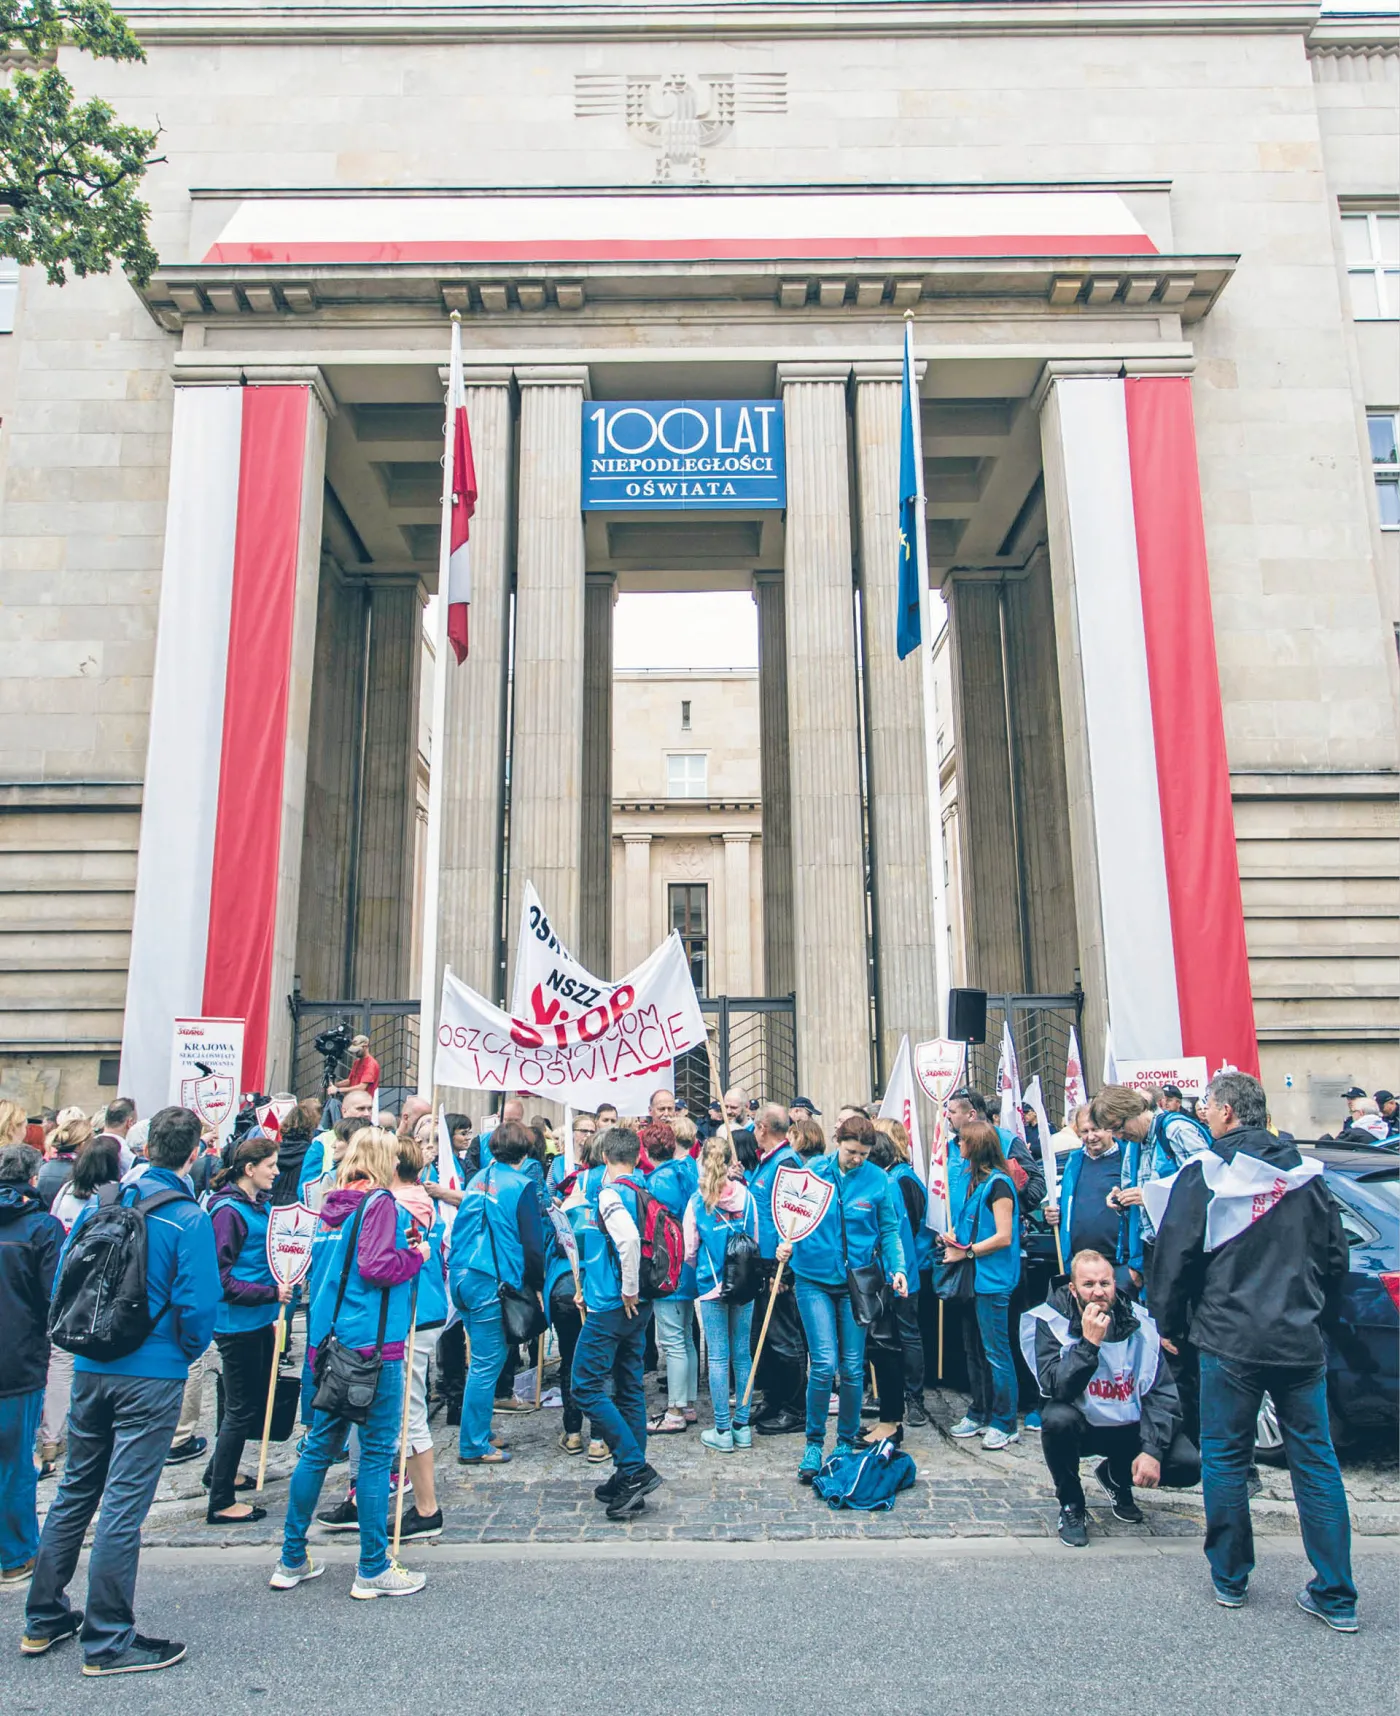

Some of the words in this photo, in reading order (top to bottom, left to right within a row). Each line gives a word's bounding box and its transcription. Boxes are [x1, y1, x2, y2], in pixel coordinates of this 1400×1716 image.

[589, 407, 709, 455] 100
[715, 406, 776, 453] LAT
[591, 454, 774, 473] NIEPODLEGŁOŚCI
[625, 479, 737, 497] OŚWIATA
[545, 968, 602, 1008] NSZZ
[184, 1043, 235, 1051] KRAJOWA
[473, 1053, 511, 1085] W
[1136, 1070, 1179, 1080] OJCOWIE
